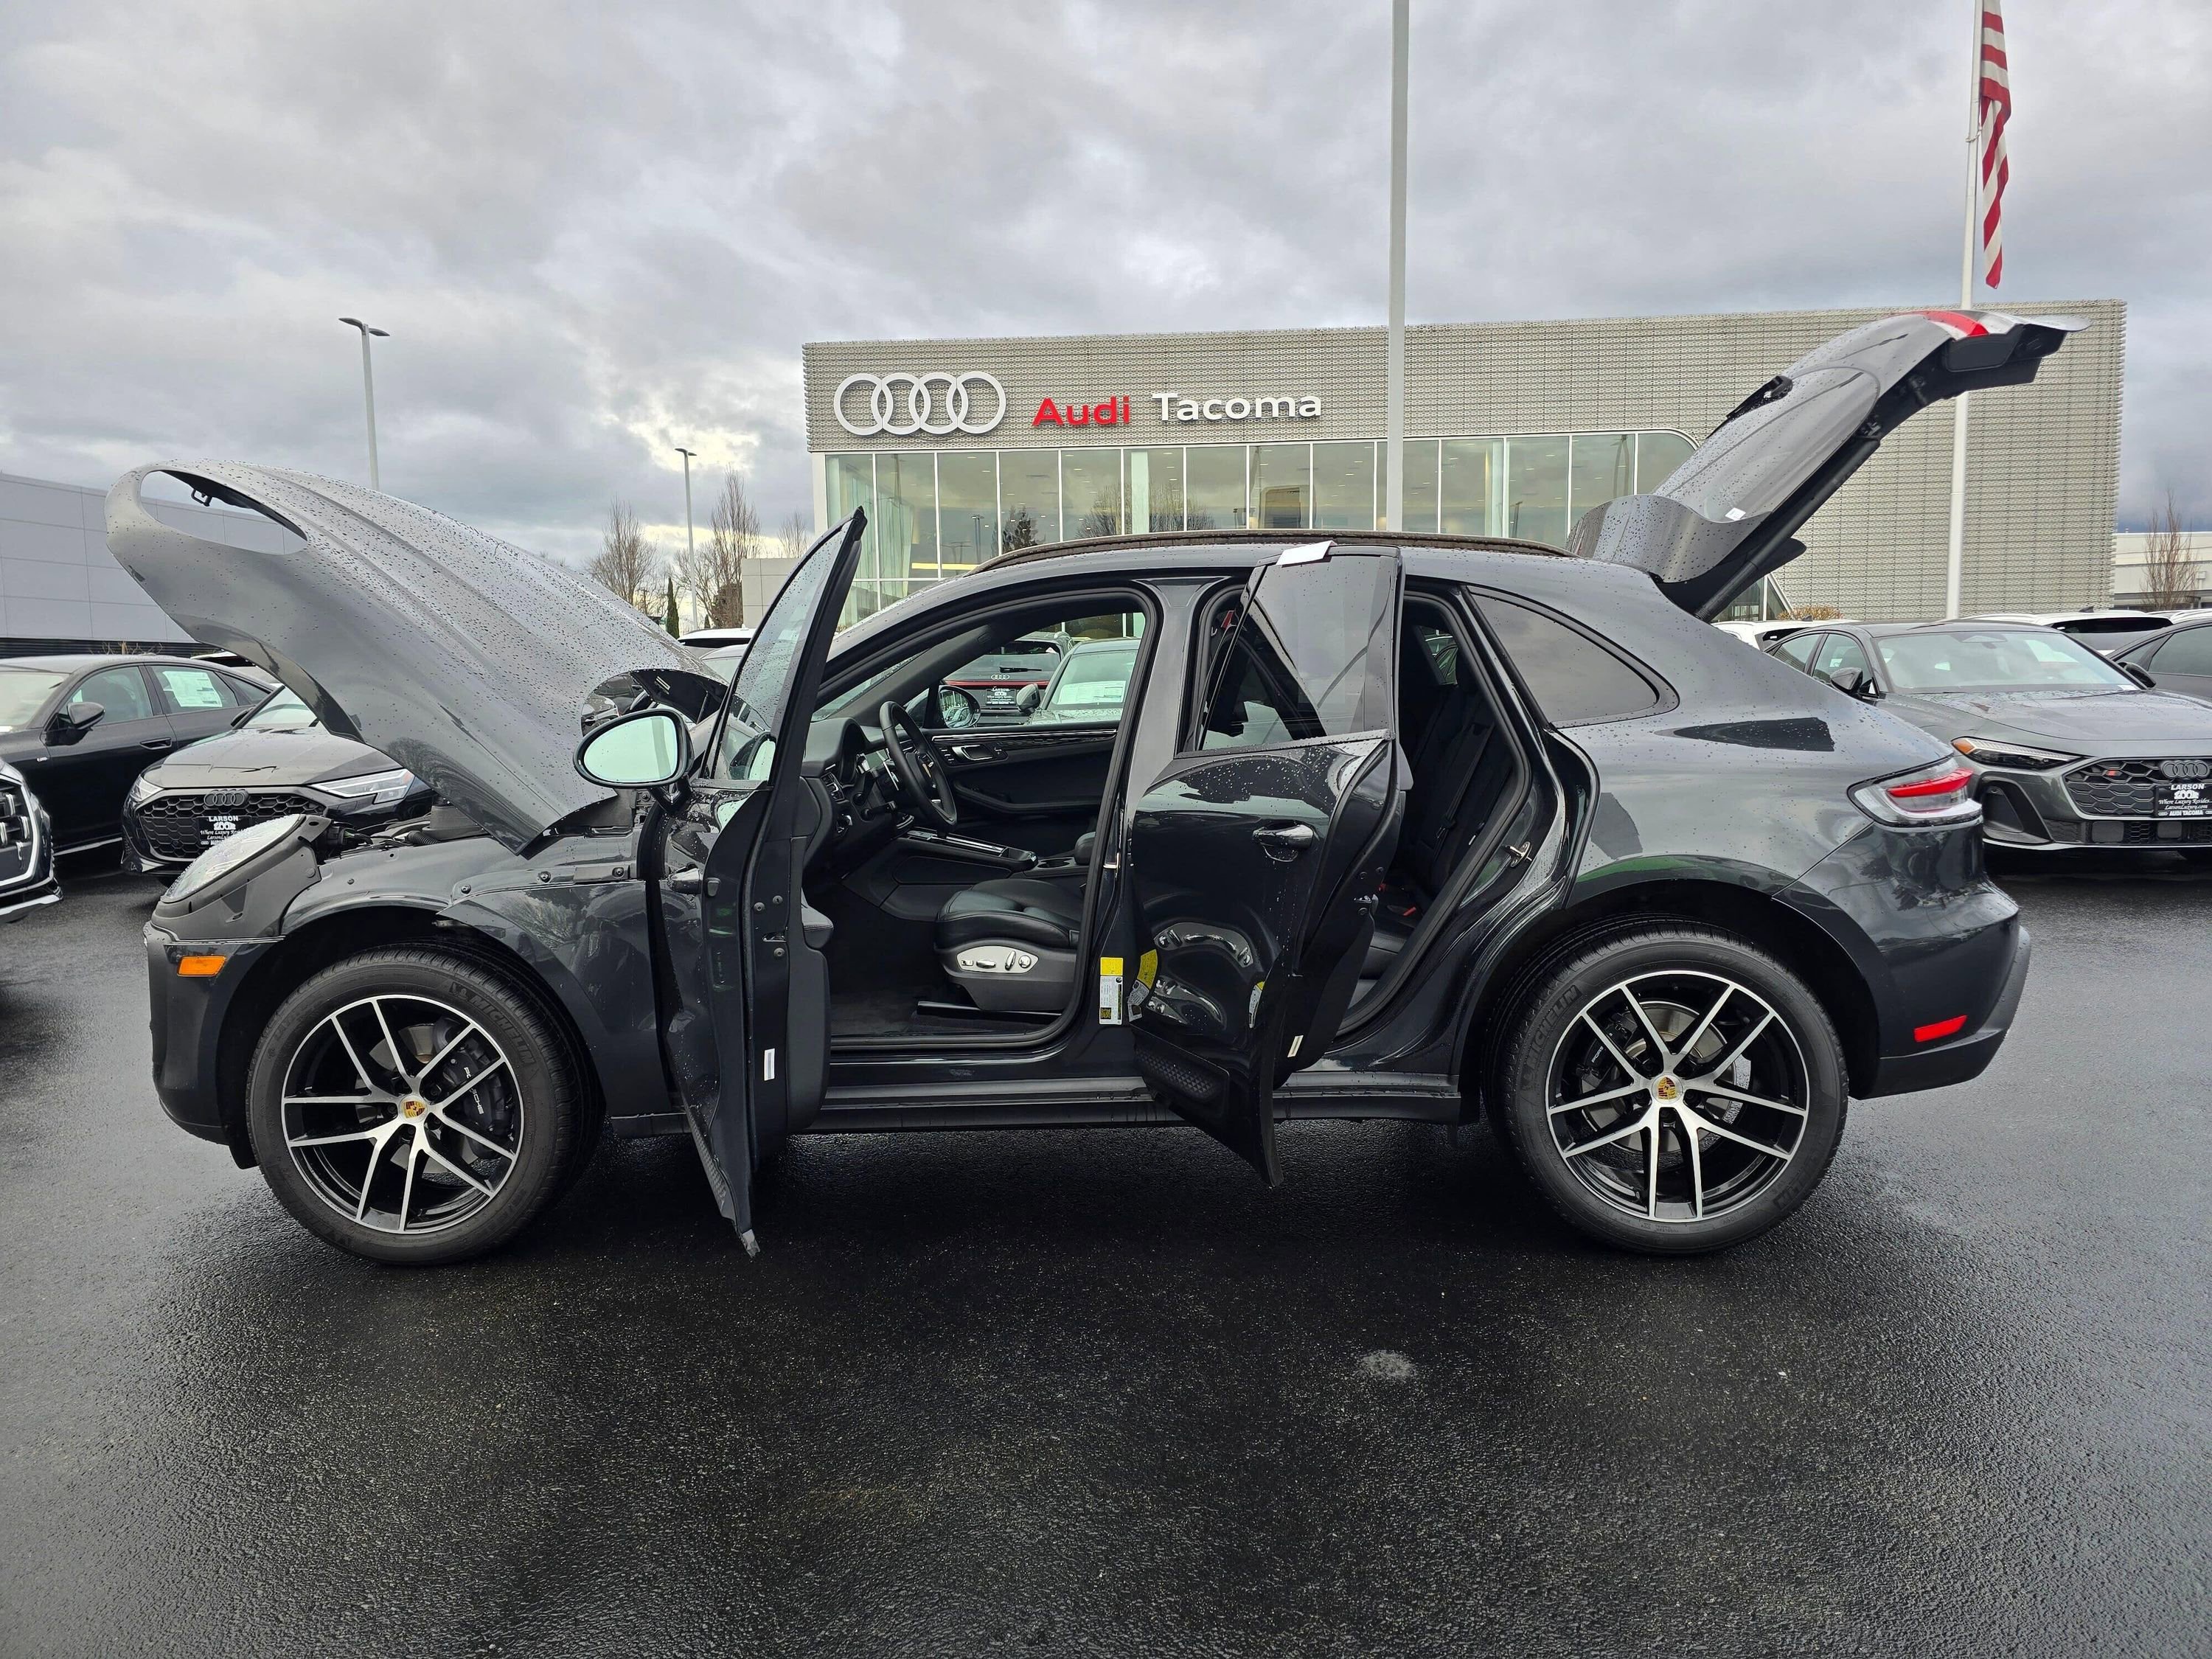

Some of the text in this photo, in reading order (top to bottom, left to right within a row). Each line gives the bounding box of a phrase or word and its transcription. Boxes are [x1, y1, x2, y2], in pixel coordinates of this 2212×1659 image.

[1032, 392, 1322, 427] Audi Tacoma
[469, 995, 536, 1063] MICHELIN
[1526, 985, 1579, 1069] MICHELIN
